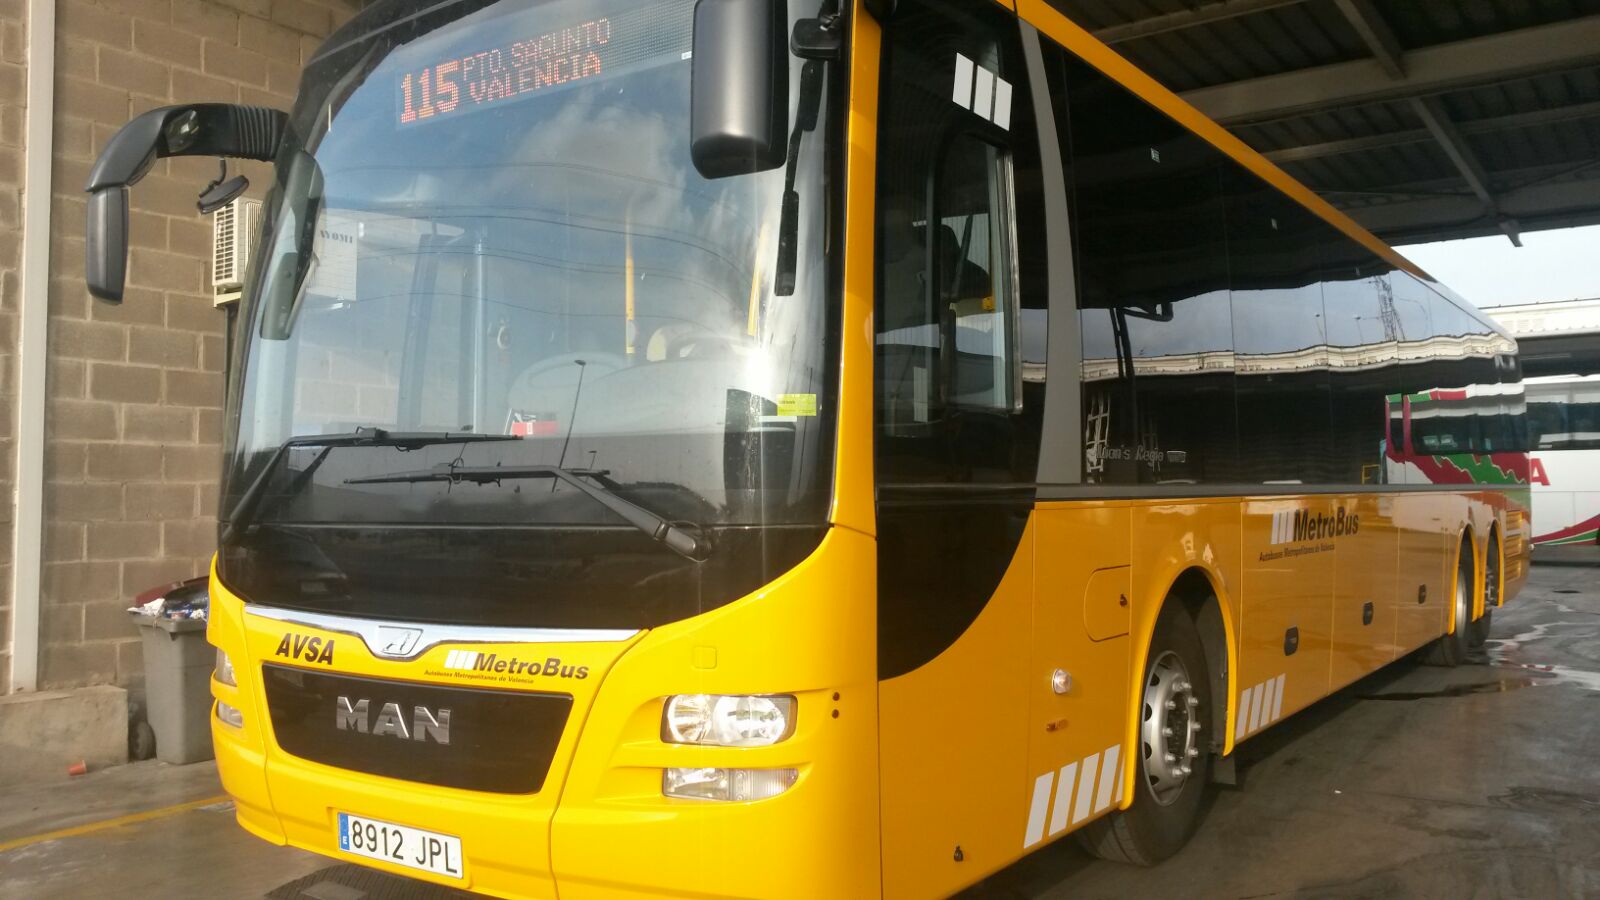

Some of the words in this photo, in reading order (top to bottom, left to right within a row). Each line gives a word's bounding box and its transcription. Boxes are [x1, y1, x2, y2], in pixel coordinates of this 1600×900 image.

[401, 61, 459, 123] 115
[469, 51, 601, 104] VALENCIA
[1293, 507, 1359, 541] MetroBus
[275, 632, 335, 665] AVSA
[473, 653, 589, 680] MetroBus
[336, 696, 452, 745] MAN
[342, 835, 348, 845] E
[352, 820, 404, 860] 8912
[415, 836, 457, 874] JPL
